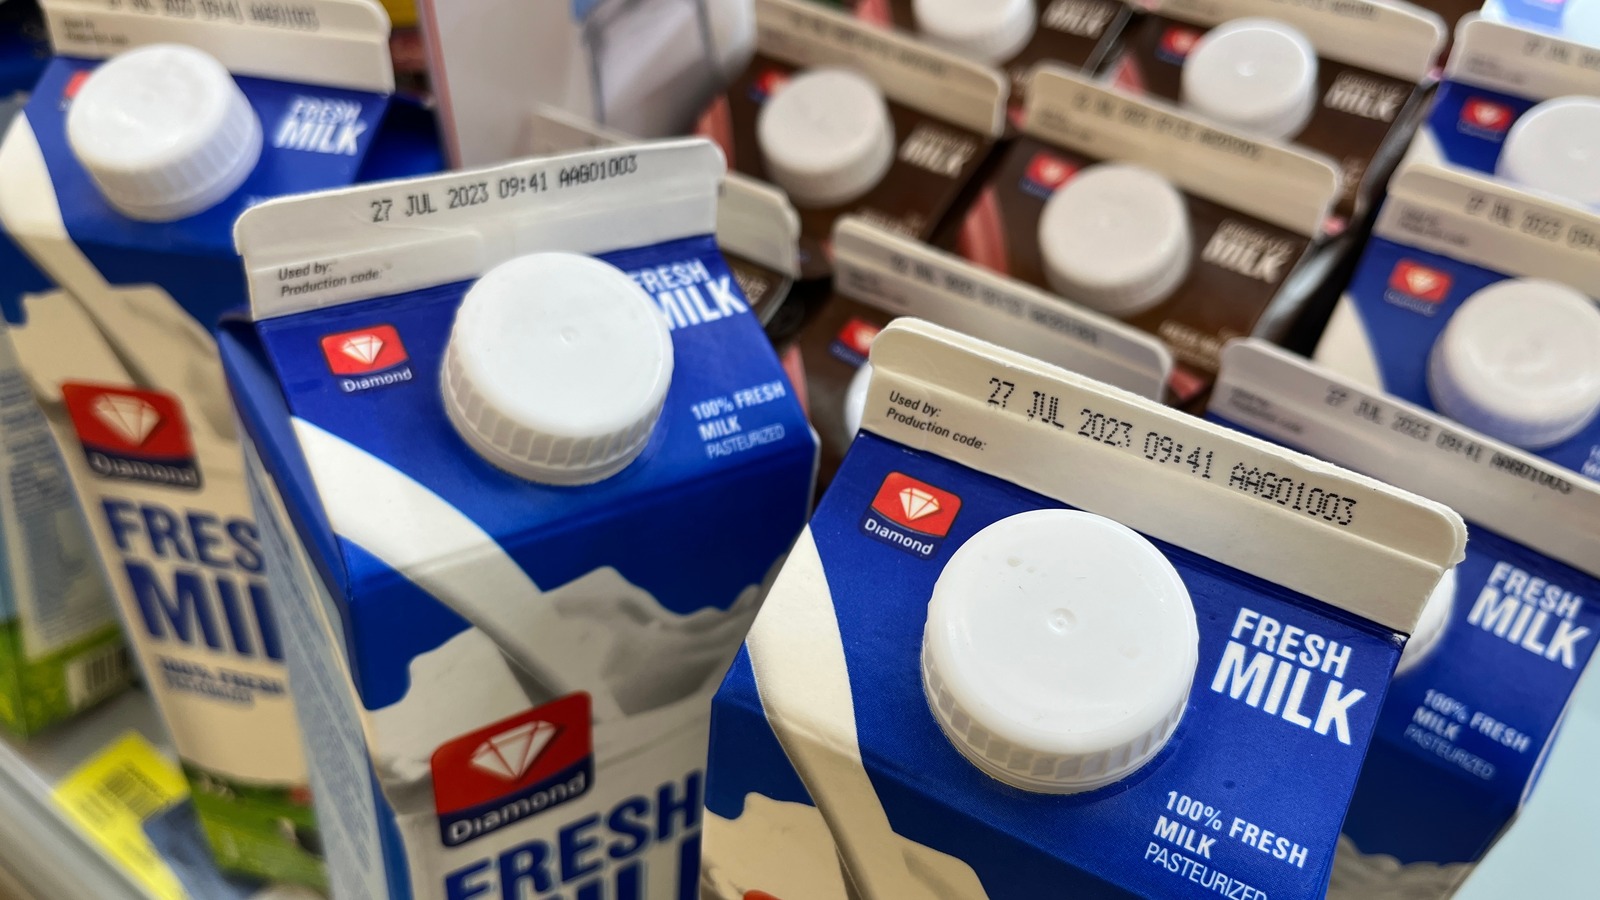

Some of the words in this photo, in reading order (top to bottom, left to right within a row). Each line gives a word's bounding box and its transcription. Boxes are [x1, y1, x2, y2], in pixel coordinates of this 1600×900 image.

[274, 119, 367, 156] MILK
[370, 199, 393, 223] 27
[404, 193, 437, 217] JUL
[447, 182, 489, 209] 2023
[499, 171, 548, 199] 09:41
[278, 263, 310, 281] Used
[280, 276, 347, 297] Production
[342, 367, 413, 393] Diamond
[690, 396, 735, 421] 100%
[733, 379, 787, 409] FRESH
[888, 390, 920, 410] Used
[921, 401, 941, 418] by:
[698, 415, 742, 442] MILK
[705, 424, 786, 460] PASTEURIZED
[886, 408, 950, 437] Production
[952, 431, 987, 451] code:
[988, 377, 1015, 408] 27
[1027, 390, 1065, 430] JUL
[1077, 408, 1133, 449] 2023
[1143, 431, 1214, 480] 09:41
[101, 498, 266, 575] FRES
[864, 517, 934, 556] Diamond
[1486, 560, 1585, 621] FRESH
[1230, 607, 1352, 679] FRESH
[1467, 586, 1593, 670] MILK
[1210, 640, 1367, 746] MILK
[1412, 706, 1462, 742] MILK
[1424, 688, 1470, 724] 100%
[1469, 711, 1532, 754] FRESH
[450, 770, 587, 843] Diamond
[1153, 815, 1217, 860] MILK
[1165, 790, 1223, 831] 100%
[1229, 817, 1310, 868] FRESH
